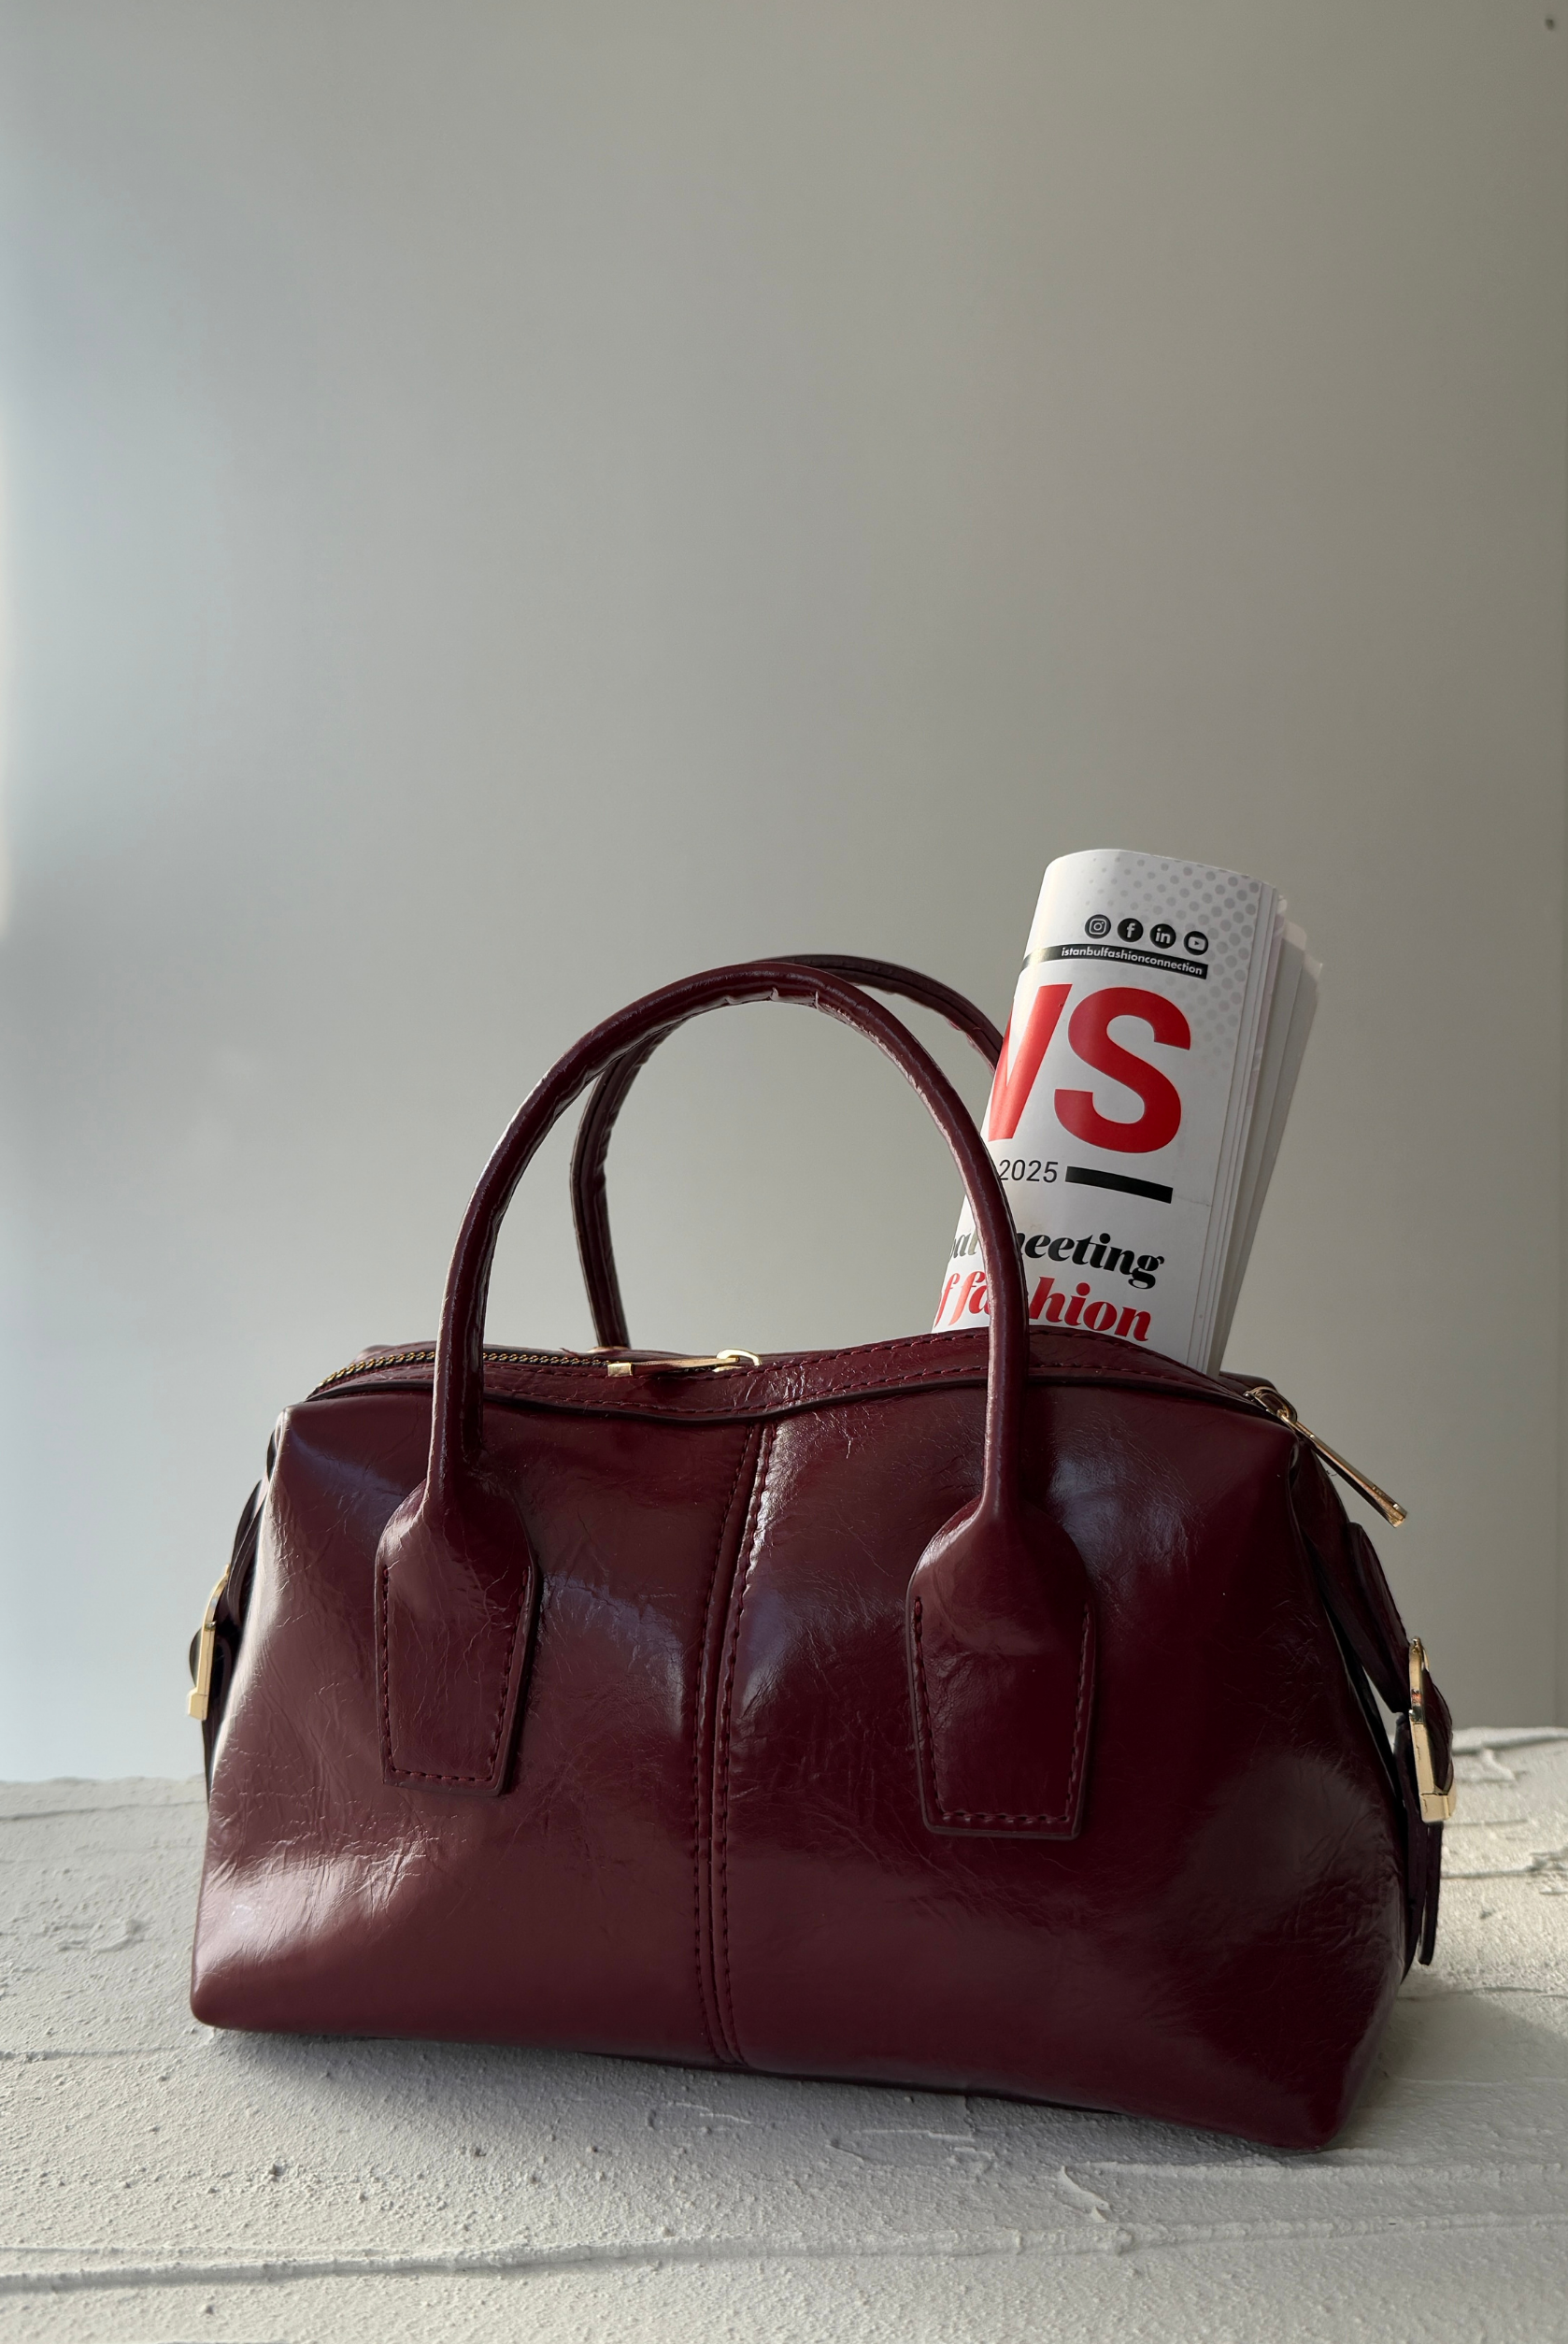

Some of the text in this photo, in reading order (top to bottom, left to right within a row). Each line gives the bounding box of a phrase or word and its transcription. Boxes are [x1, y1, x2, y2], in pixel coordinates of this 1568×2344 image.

[1061, 947, 1204, 976] istanbulfashionconnection
[998, 1159, 1059, 1183] 2025
[1016, 1231, 1165, 1290] eeting
[948, 1270, 1152, 1342] fahion
